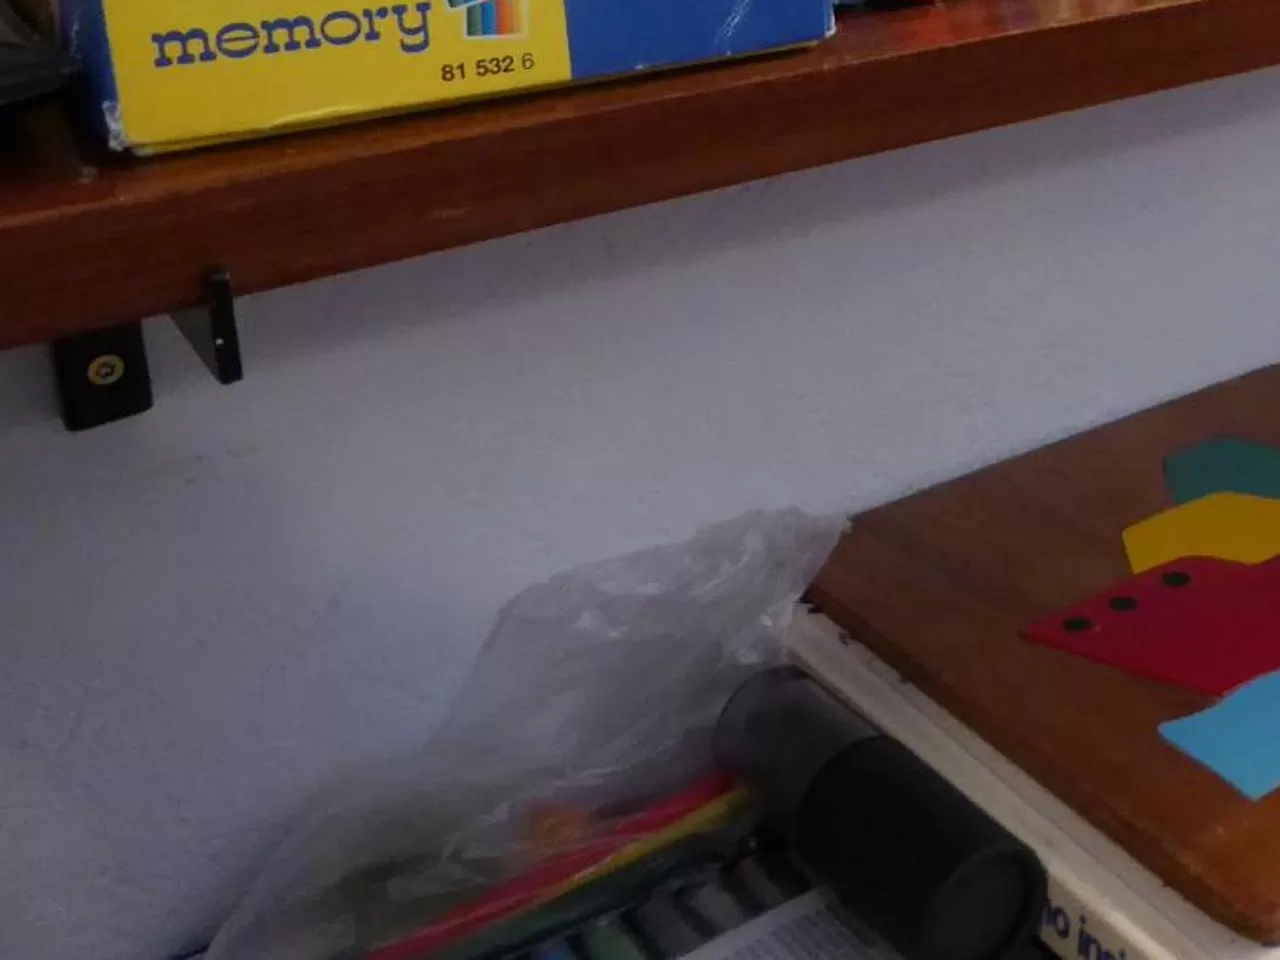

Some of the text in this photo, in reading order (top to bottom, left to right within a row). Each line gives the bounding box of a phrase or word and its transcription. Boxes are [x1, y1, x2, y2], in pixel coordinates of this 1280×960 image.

[151, 0, 431, 69] memory
[441, 53, 534, 82] 81 532 6
